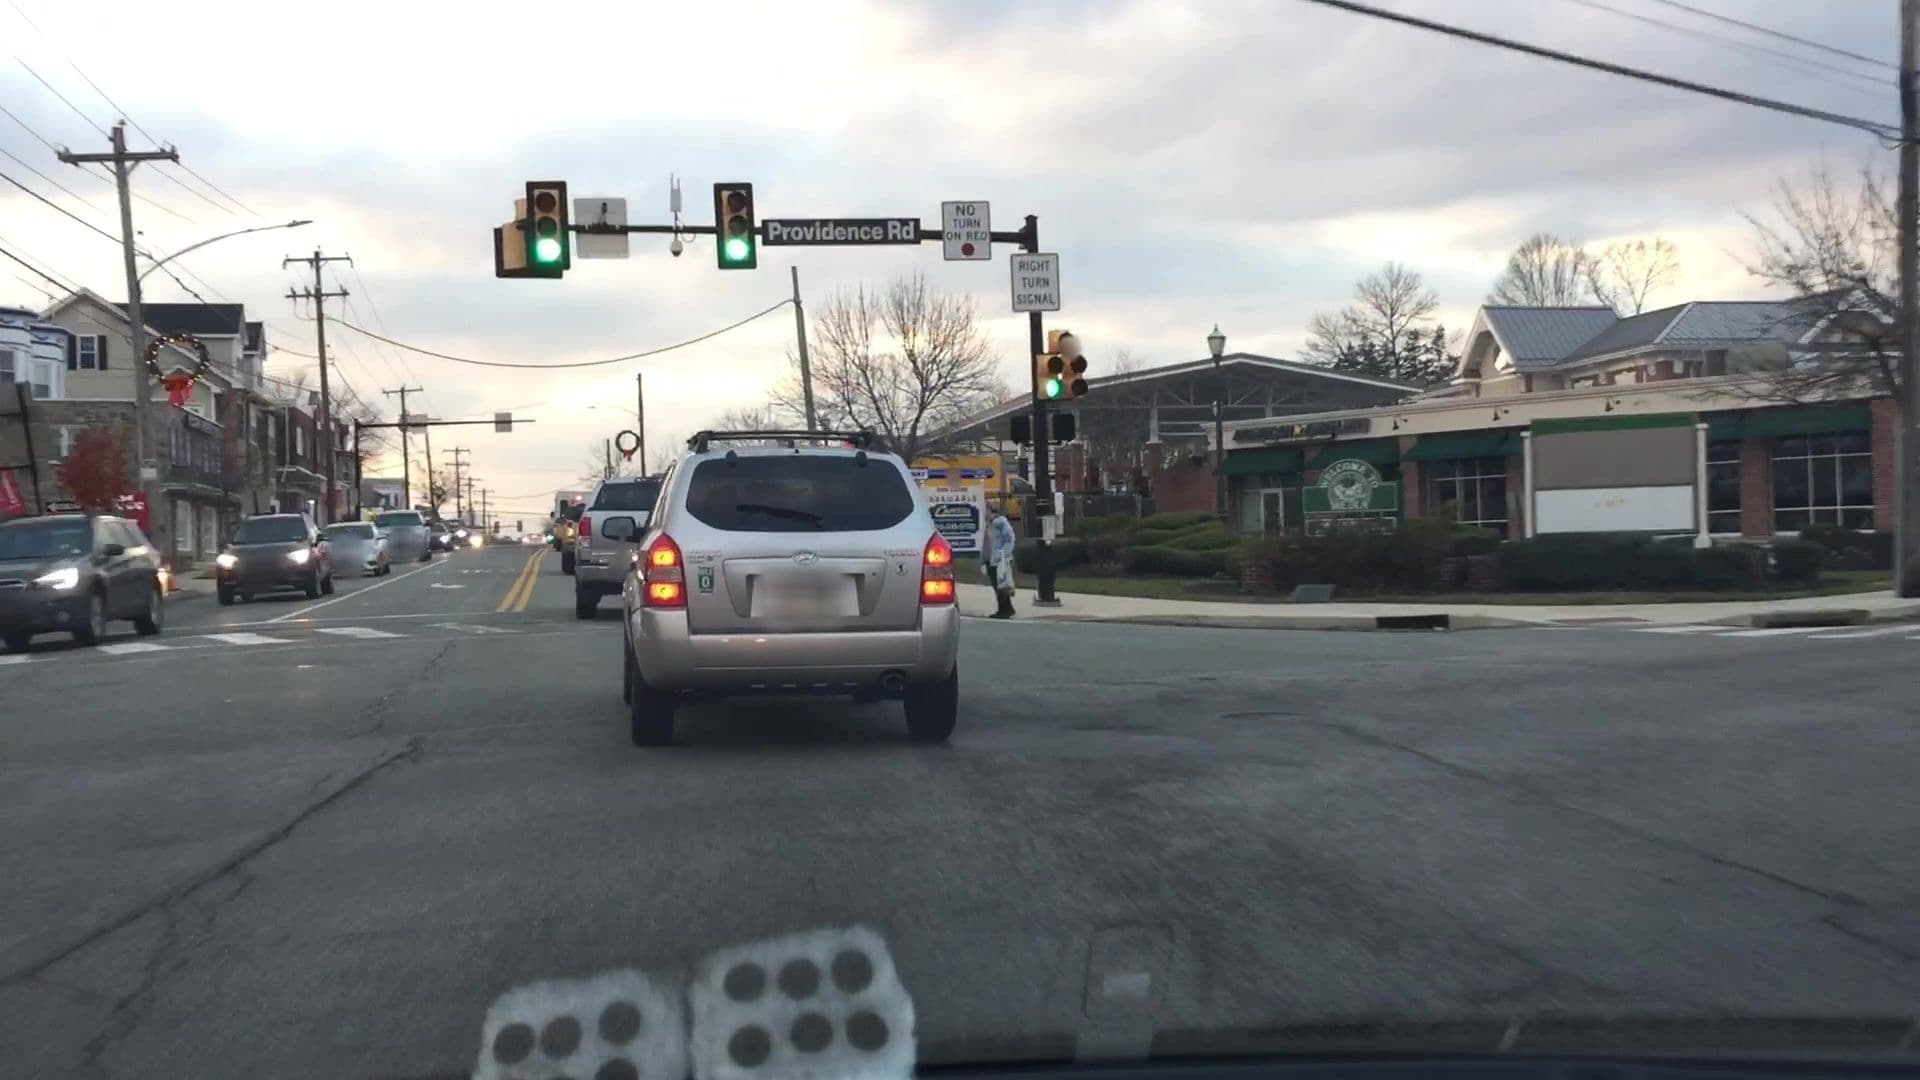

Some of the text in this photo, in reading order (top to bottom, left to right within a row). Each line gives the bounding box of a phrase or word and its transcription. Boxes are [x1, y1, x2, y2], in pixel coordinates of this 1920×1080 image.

[955, 204, 975, 216] NO
[953, 218, 981, 229] TURN
[767, 220, 915, 241] Providence Rd
[946, 231, 988, 241] ON RED
[1018, 260, 1050, 272] RIGHT
[1021, 276, 1050, 289] TURN
[1016, 293, 1056, 306] SIGNAL
